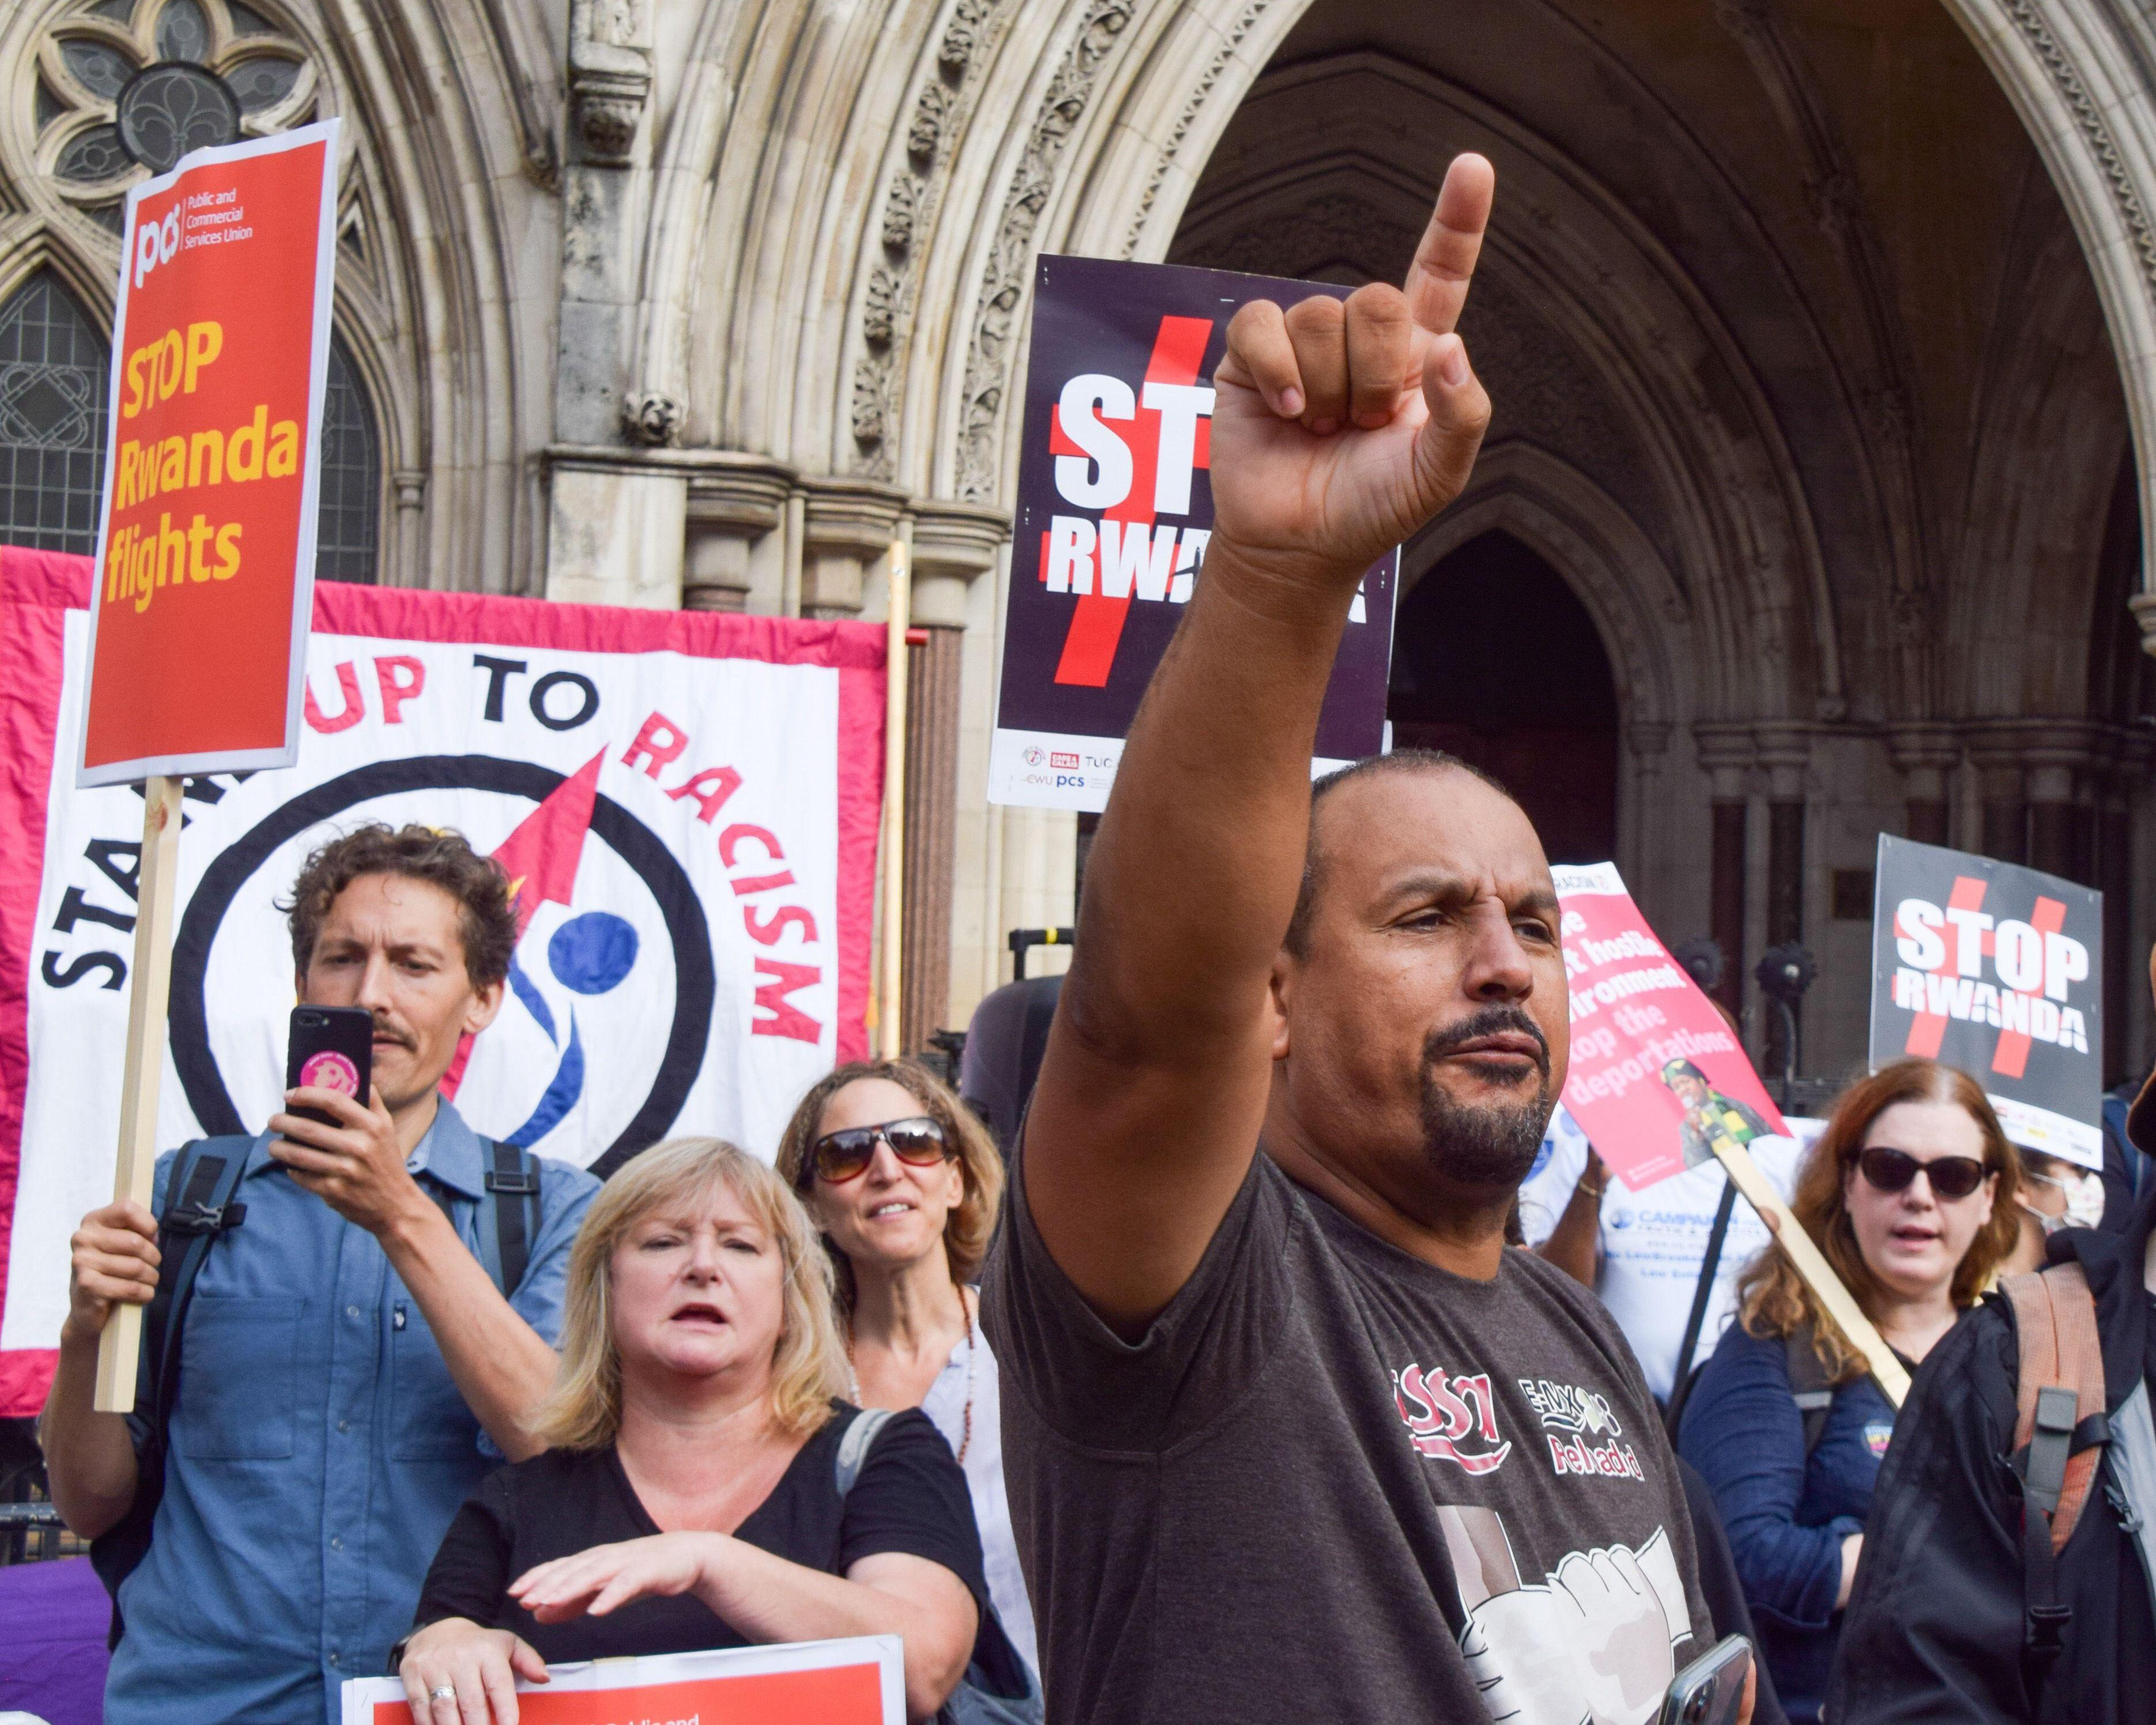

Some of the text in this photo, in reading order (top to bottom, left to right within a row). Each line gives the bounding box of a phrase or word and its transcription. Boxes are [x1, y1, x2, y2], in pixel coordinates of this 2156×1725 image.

[186, 206, 244, 229] Commercial
[188, 187, 237, 209] Public and
[184, 226, 254, 249] Services Union
[123, 320, 223, 419] STOP
[116, 405, 299, 511] Rwanda
[1055, 373, 1217, 516] ST
[107, 512, 242, 613] flights
[1056, 775, 1085, 788] pcs
[1085, 756, 1113, 768] TUC
[304, 655, 426, 734] UP
[473, 654, 600, 731] TO
[620, 711, 822, 1045] RACISM
[1579, 930, 1664, 966] hostile
[1896, 898, 2089, 1002] STOP
[1569, 963, 1687, 1024] ironment
[1611, 1005, 1668, 1036] the
[1896, 967, 2089, 1055] RWANDA
[1568, 1028, 1735, 1106] deportations
